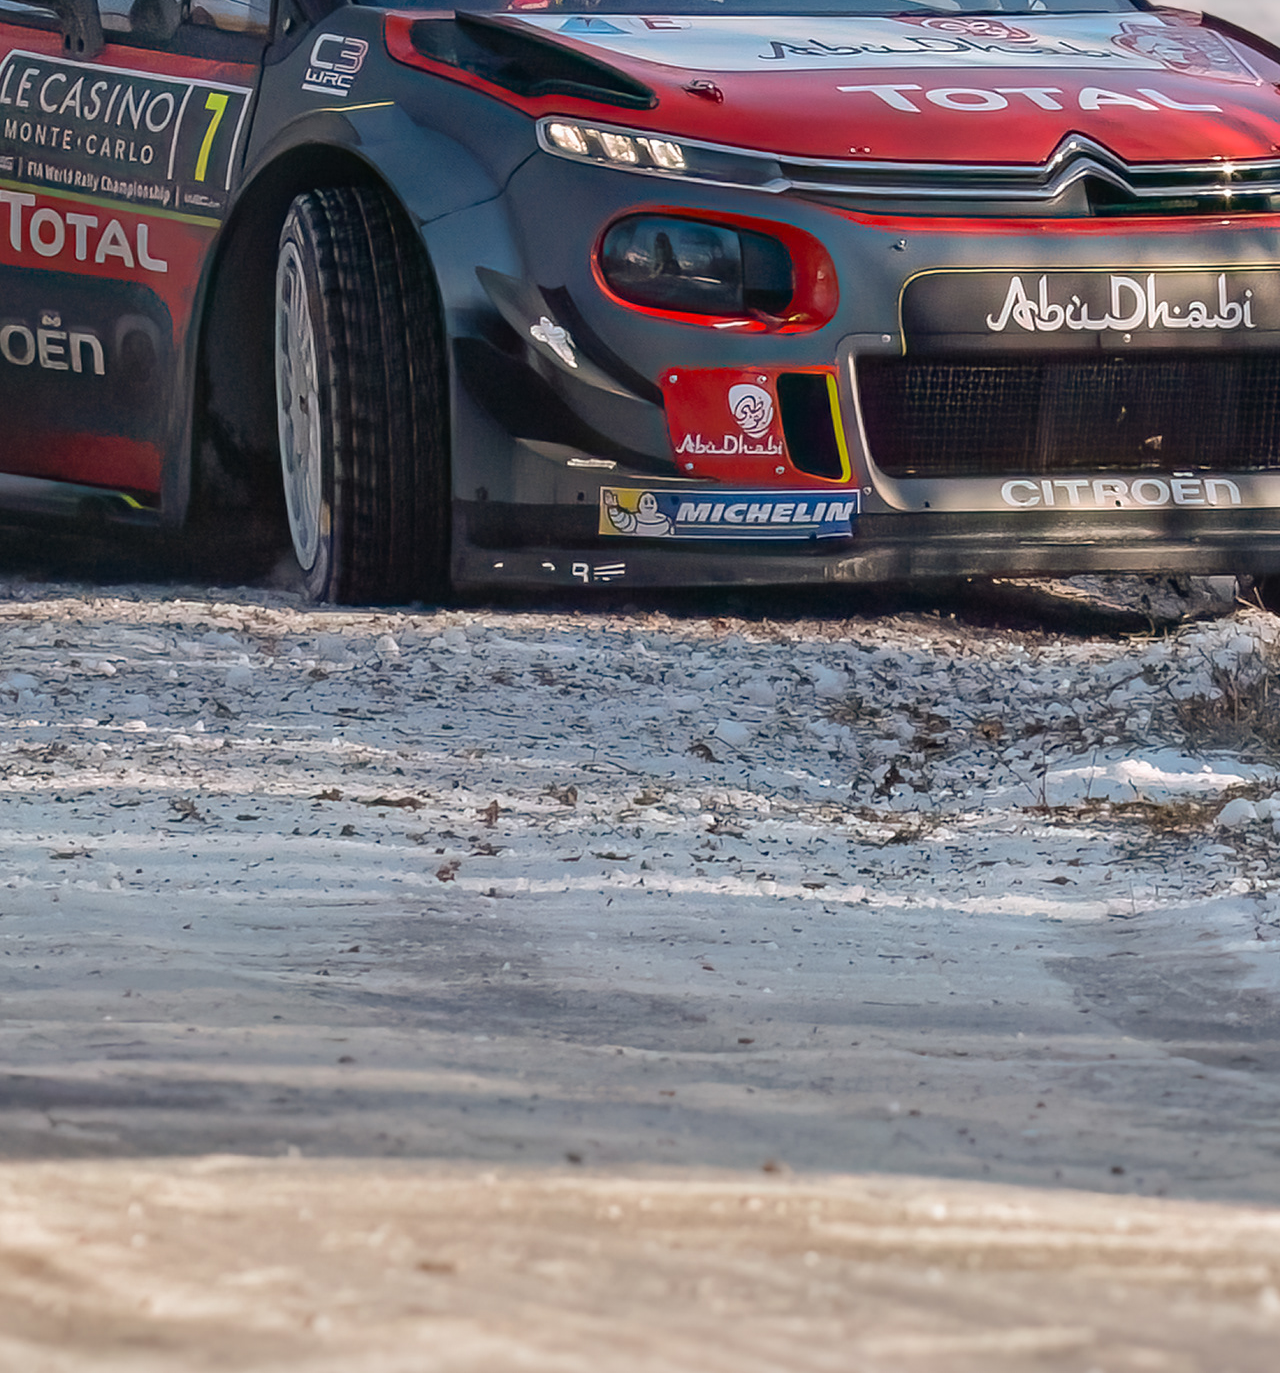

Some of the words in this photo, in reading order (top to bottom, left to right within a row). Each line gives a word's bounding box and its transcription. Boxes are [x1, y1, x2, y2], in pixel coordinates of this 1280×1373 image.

[310, 33, 369, 74] C3
[305, 68, 354, 88] WRC
[0, 64, 41, 108] LE
[39, 72, 175, 133] CASINO
[836, 83, 1224, 113] TOTAL
[194, 92, 230, 182] 7
[26, 160, 44, 178] FIA
[675, 501, 856, 524] MICHELIN
